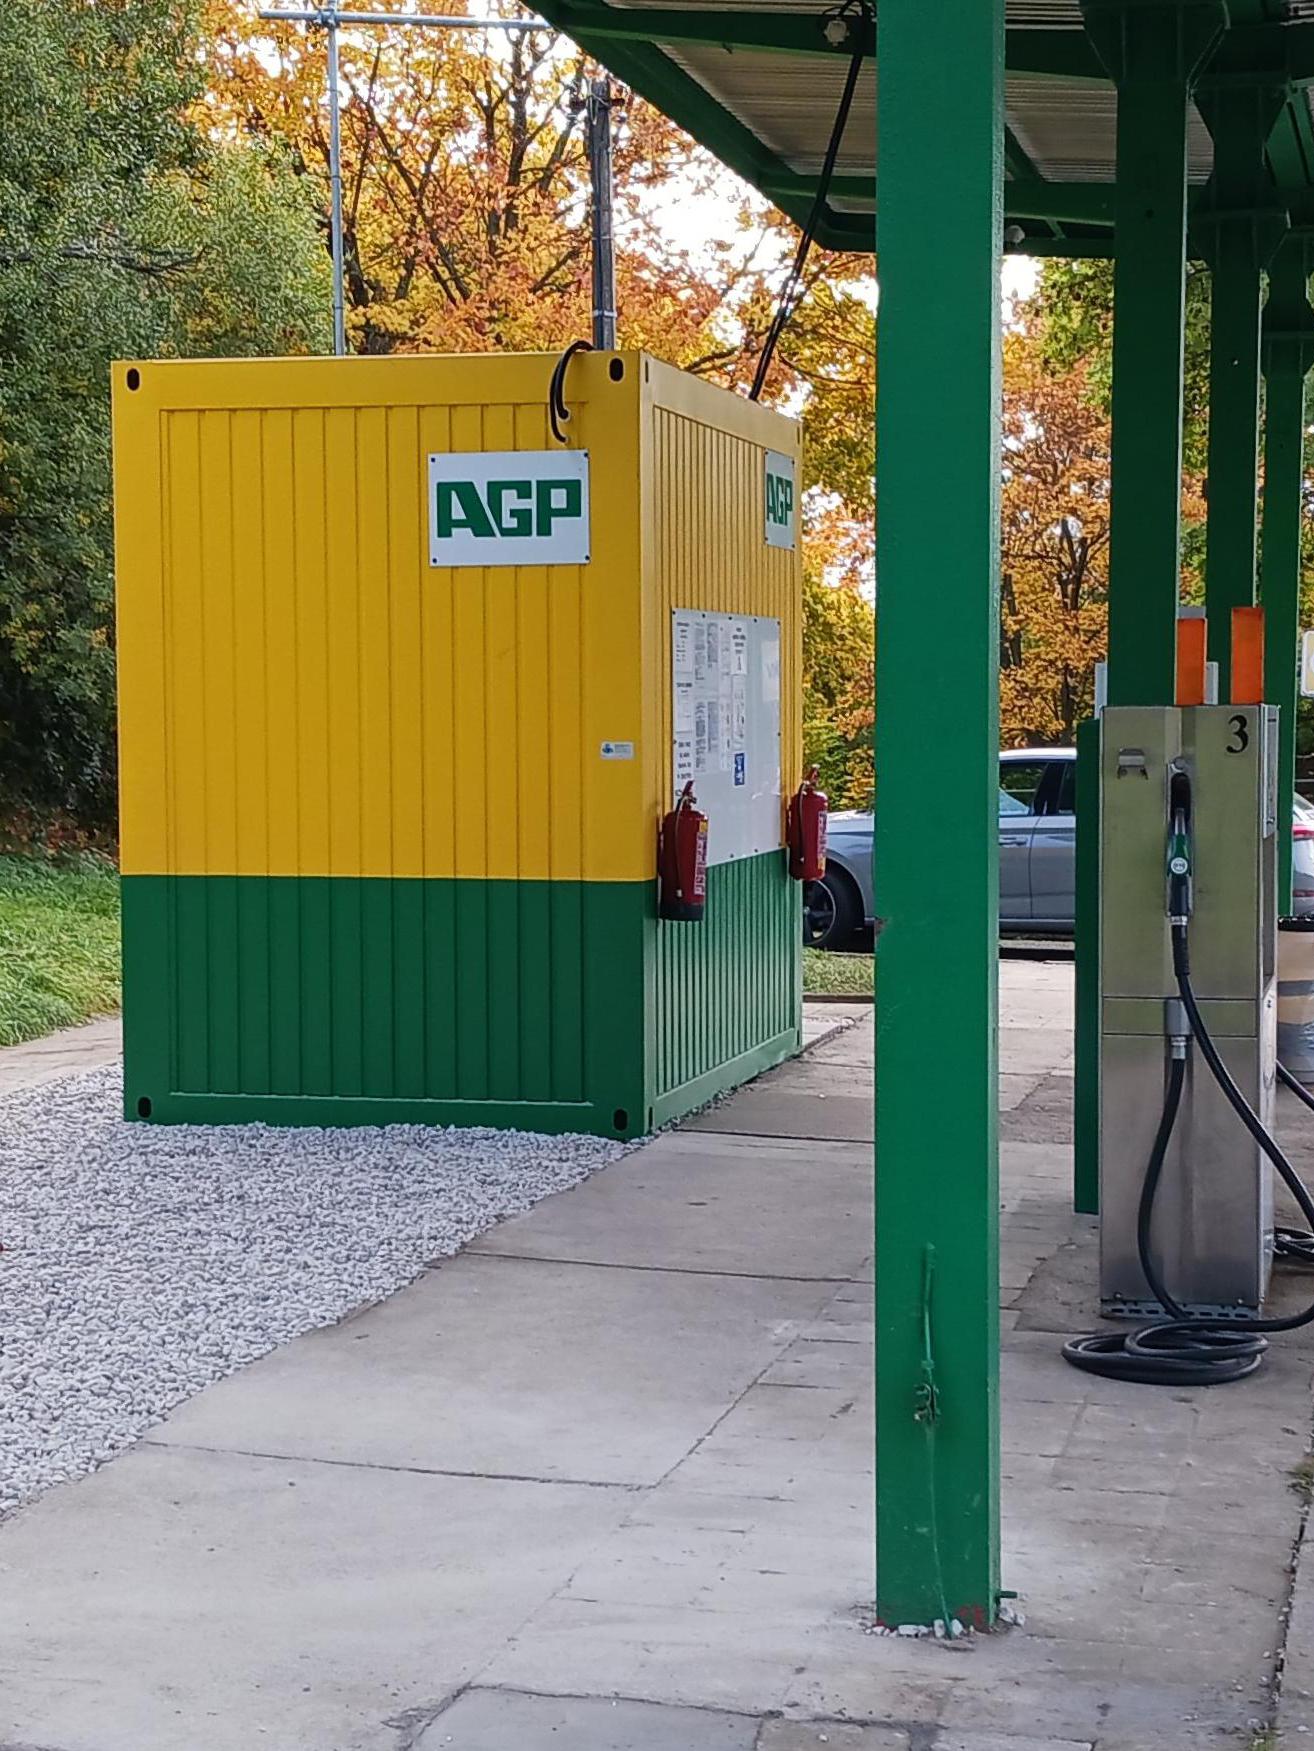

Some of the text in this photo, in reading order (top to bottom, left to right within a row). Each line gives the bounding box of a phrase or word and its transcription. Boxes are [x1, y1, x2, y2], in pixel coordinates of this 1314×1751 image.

[436, 479, 582, 538] AGP
[766, 473, 793, 526] AGP
[1226, 715, 1249, 754] 3
